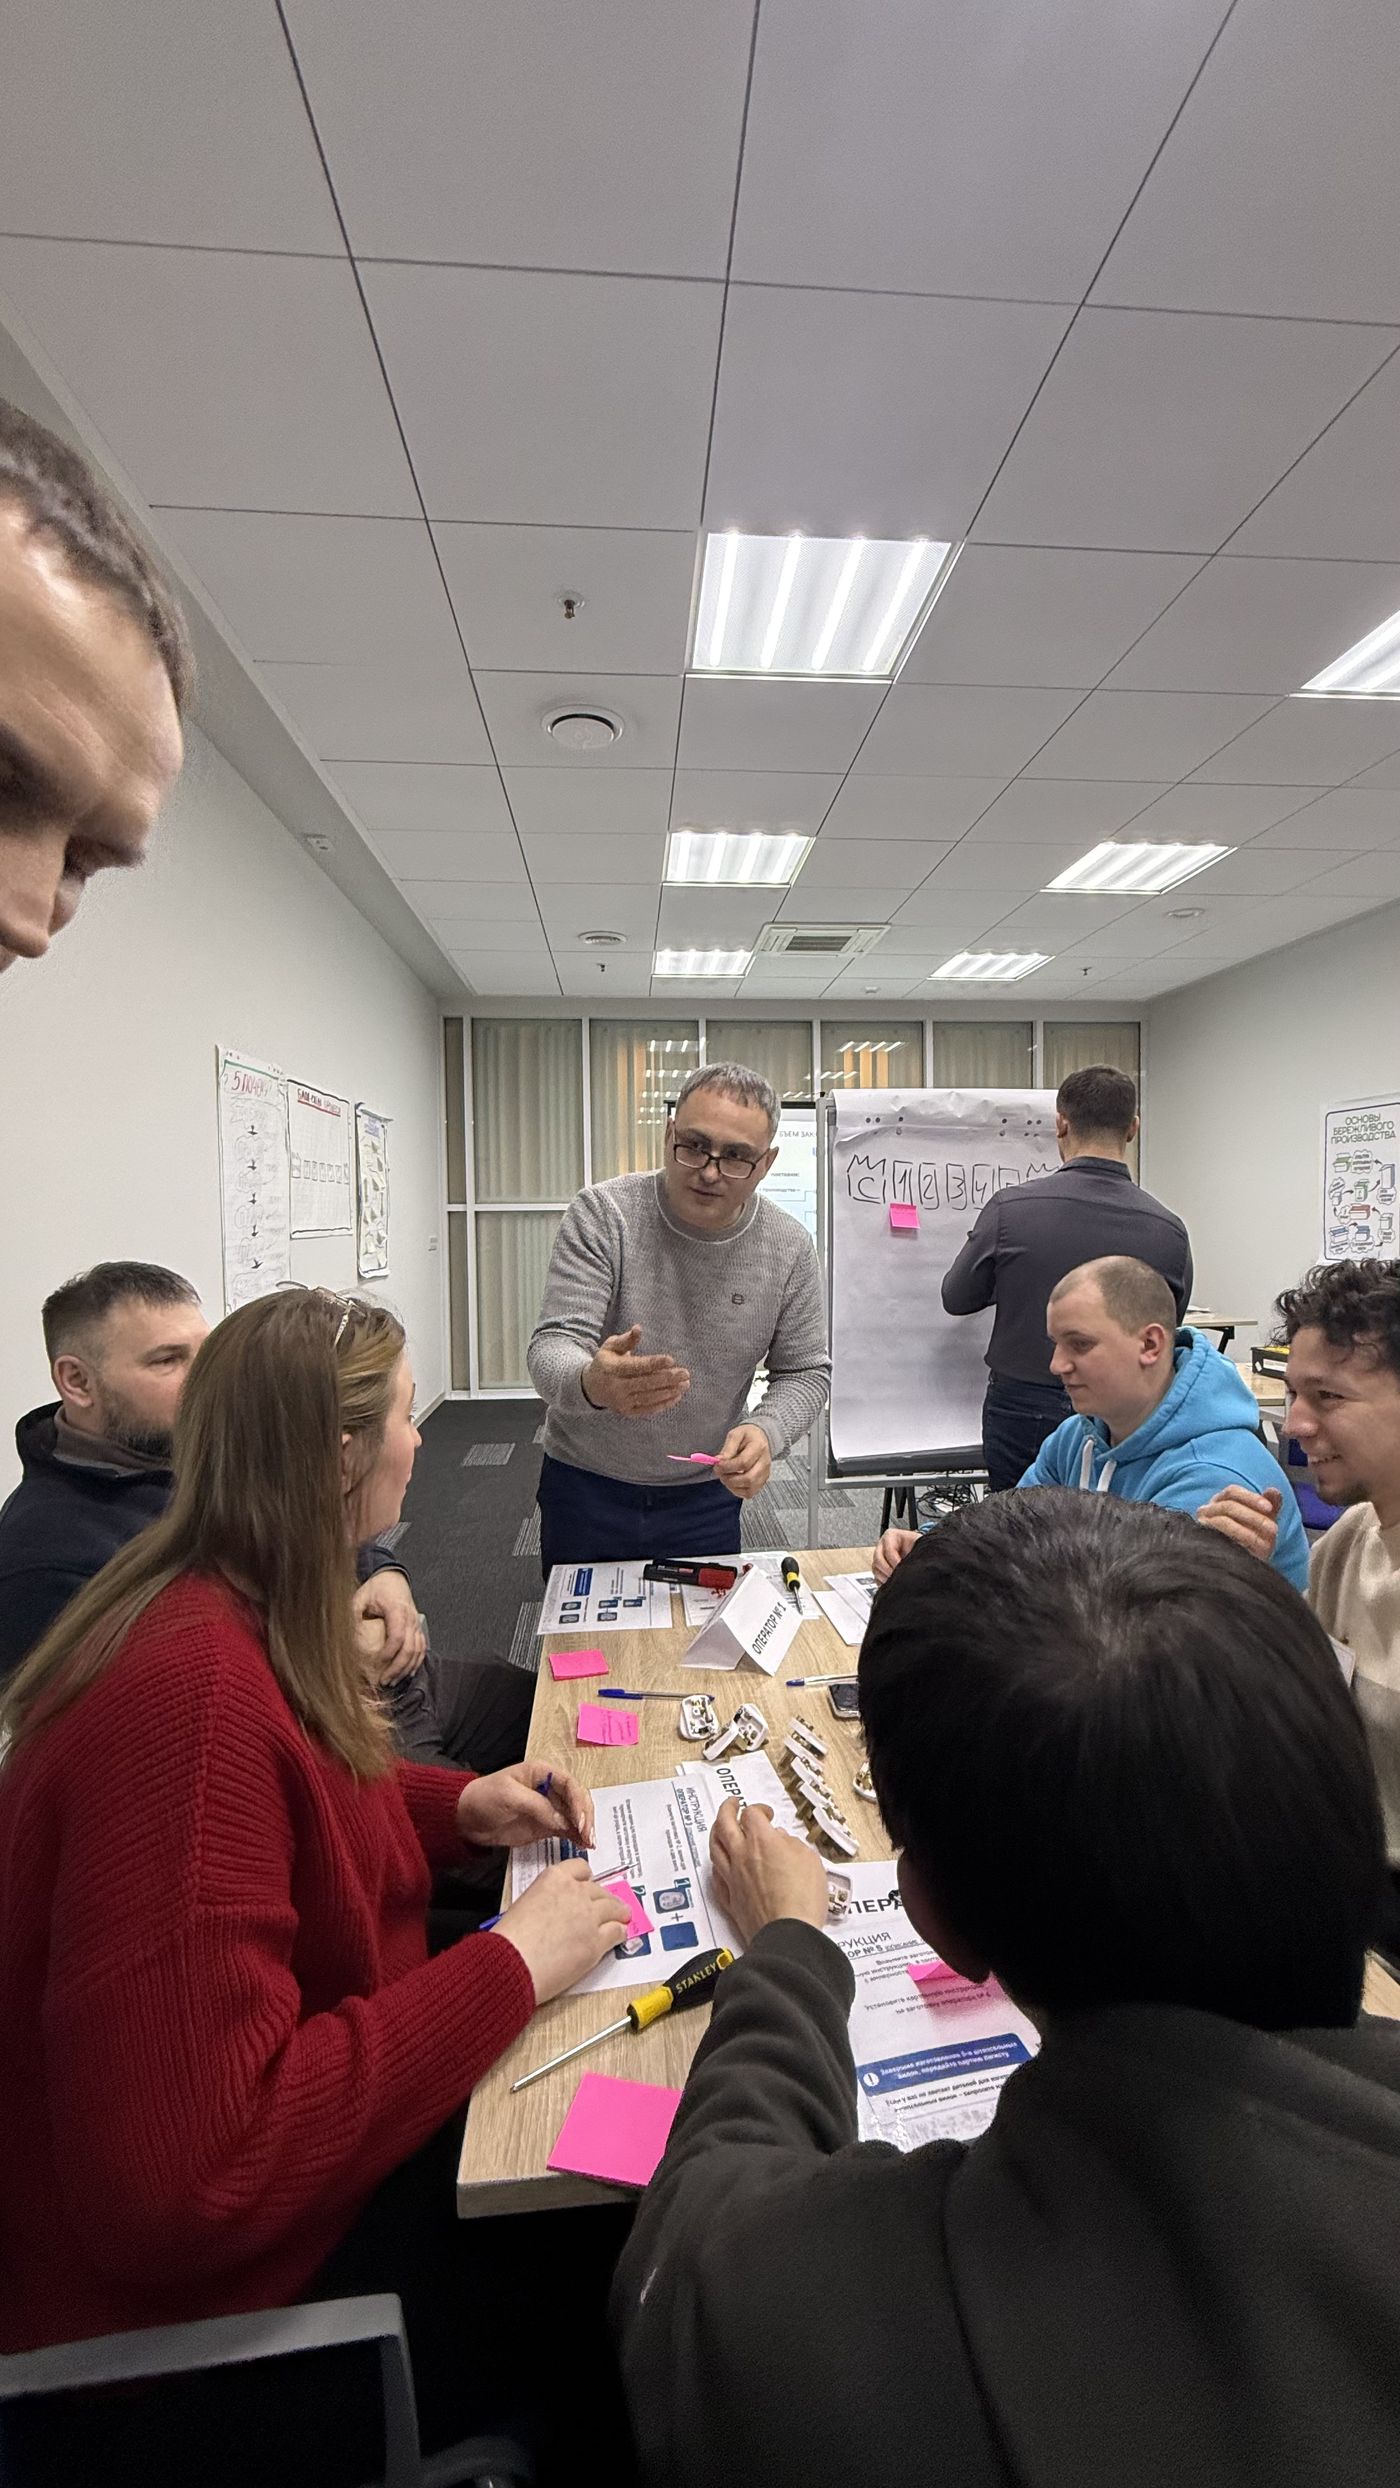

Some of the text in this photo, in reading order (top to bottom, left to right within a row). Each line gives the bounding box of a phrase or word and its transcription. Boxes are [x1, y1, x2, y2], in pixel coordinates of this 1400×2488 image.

[1345, 1113, 1381, 1125] ОСНОВЫ
[1333, 1120, 1394, 1135] БЕРЕЖЛИВОГО
[1330, 1130, 1396, 1144] ПРОИЗВОДСТВА
[899, 1169, 907, 1202] 1
[922, 1174, 936, 1200] 2
[950, 1176, 966, 1200] 3
[975, 1180, 988, 1204] 4
[752, 1614, 778, 1655] ОПЕРАТОР
[777, 1601, 786, 1611] 1
[676, 1788, 690, 1816] ОПЕРАТОР
[686, 1787, 708, 1832] ИНСТРУКЦИЯ
[675, 1880, 690, 1888] 1
[838, 1932, 892, 1948] РУКЦИЯ
[848, 1950, 861, 1958] ОР
[676, 1962, 717, 1994] STANLEY
